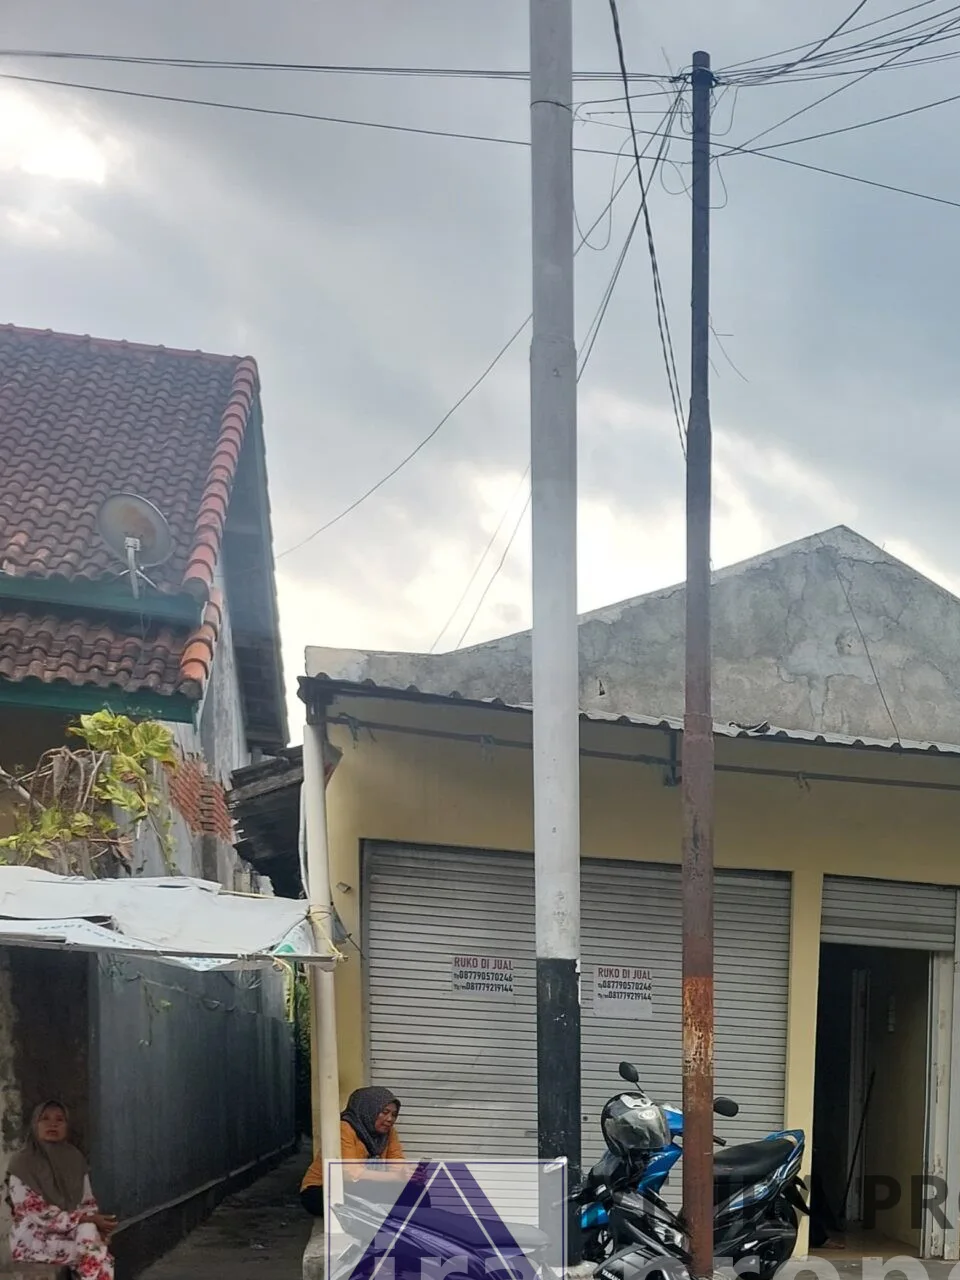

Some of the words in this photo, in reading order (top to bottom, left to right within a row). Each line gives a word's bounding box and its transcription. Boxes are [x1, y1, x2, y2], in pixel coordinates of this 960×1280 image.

[454, 957, 478, 968] RUKO
[481, 958, 489, 969] DI
[492, 960, 514, 970] JUAL
[598, 968, 620, 978] RUKO
[622, 969, 630, 979] DI
[633, 970, 652, 980] JUAL
